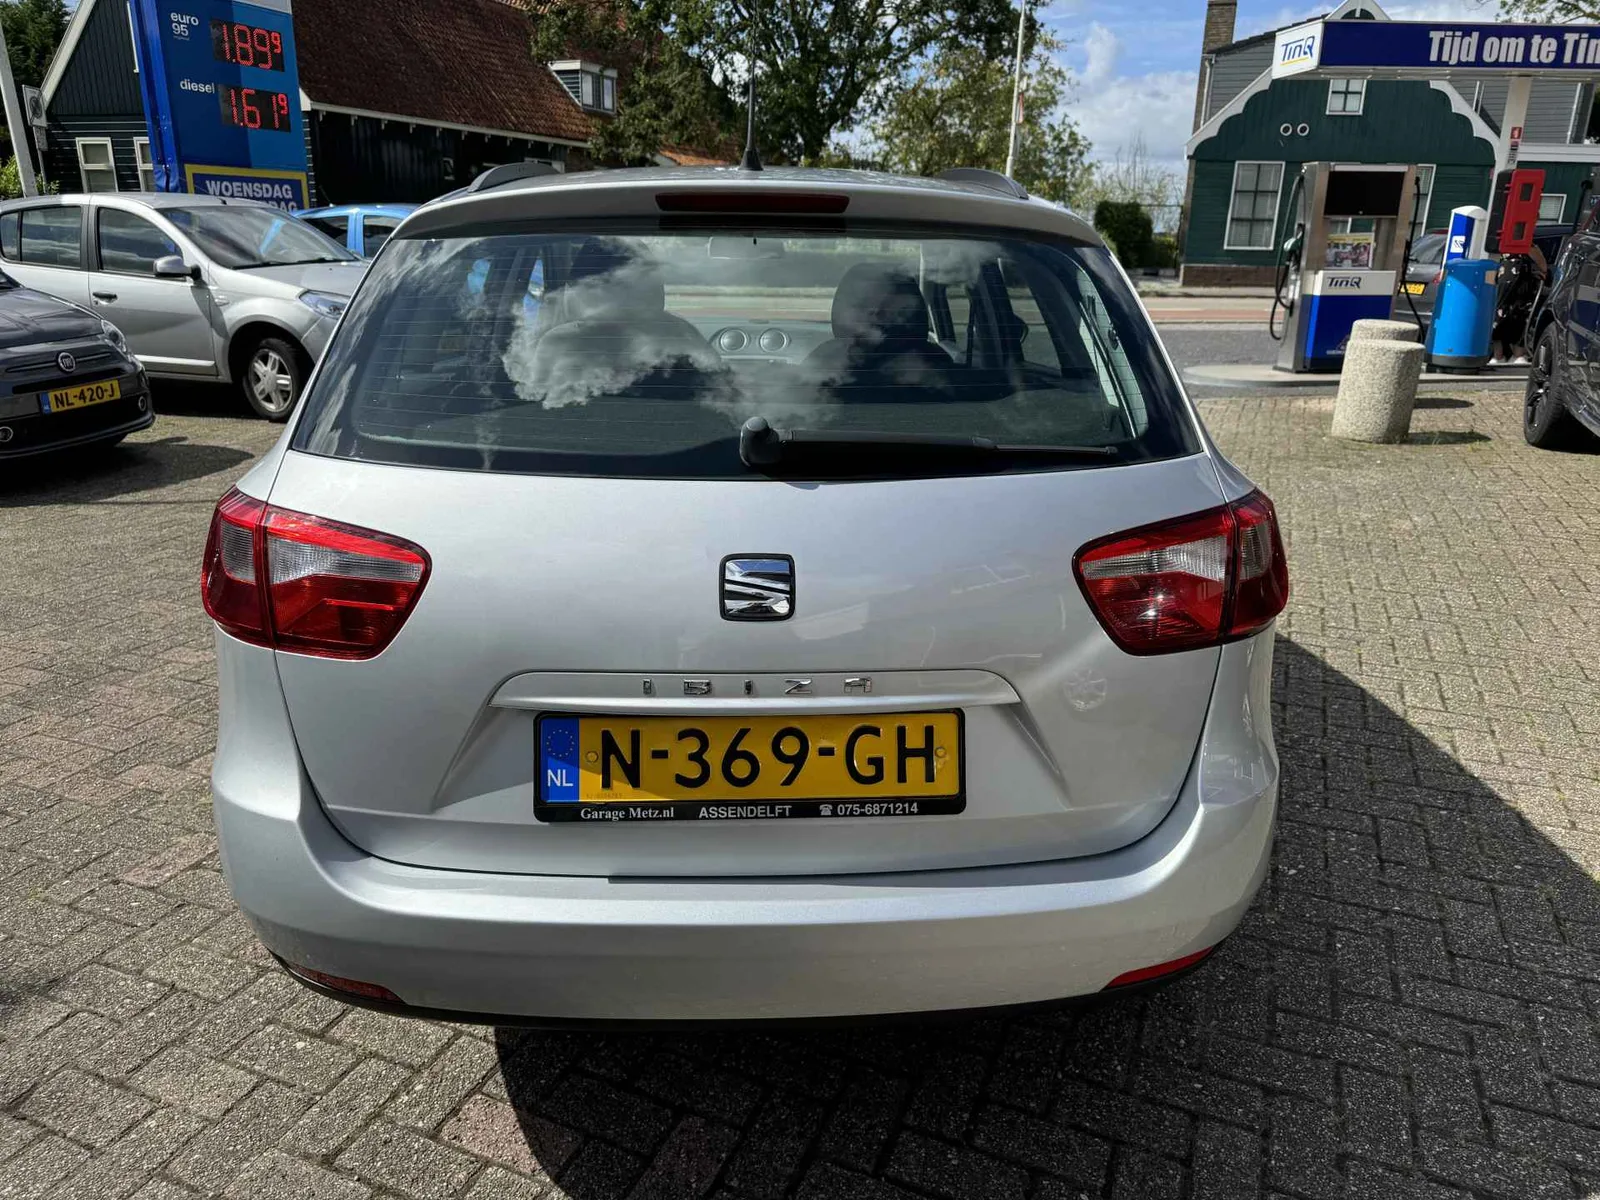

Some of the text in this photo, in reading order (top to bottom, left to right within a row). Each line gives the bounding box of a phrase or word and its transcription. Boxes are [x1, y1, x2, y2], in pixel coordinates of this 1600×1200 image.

[170, 12, 199, 26] euro
[171, 23, 189, 37] 95
[1429, 30, 1480, 65] Tijd
[1482, 36, 1526, 63] om
[1529, 33, 1558, 64] te
[180, 79, 215, 94] diesel
[205, 180, 293, 199] WOENSDAG
[53, 382, 115, 409] NL-420-J
[643, 677, 873, 695] IBIZA
[601, 725, 936, 790] N-369-GH
[547, 769, 574, 787] NL
[580, 802, 919, 821] Garage Metz.nl ASSENDELFT 075-6871214
